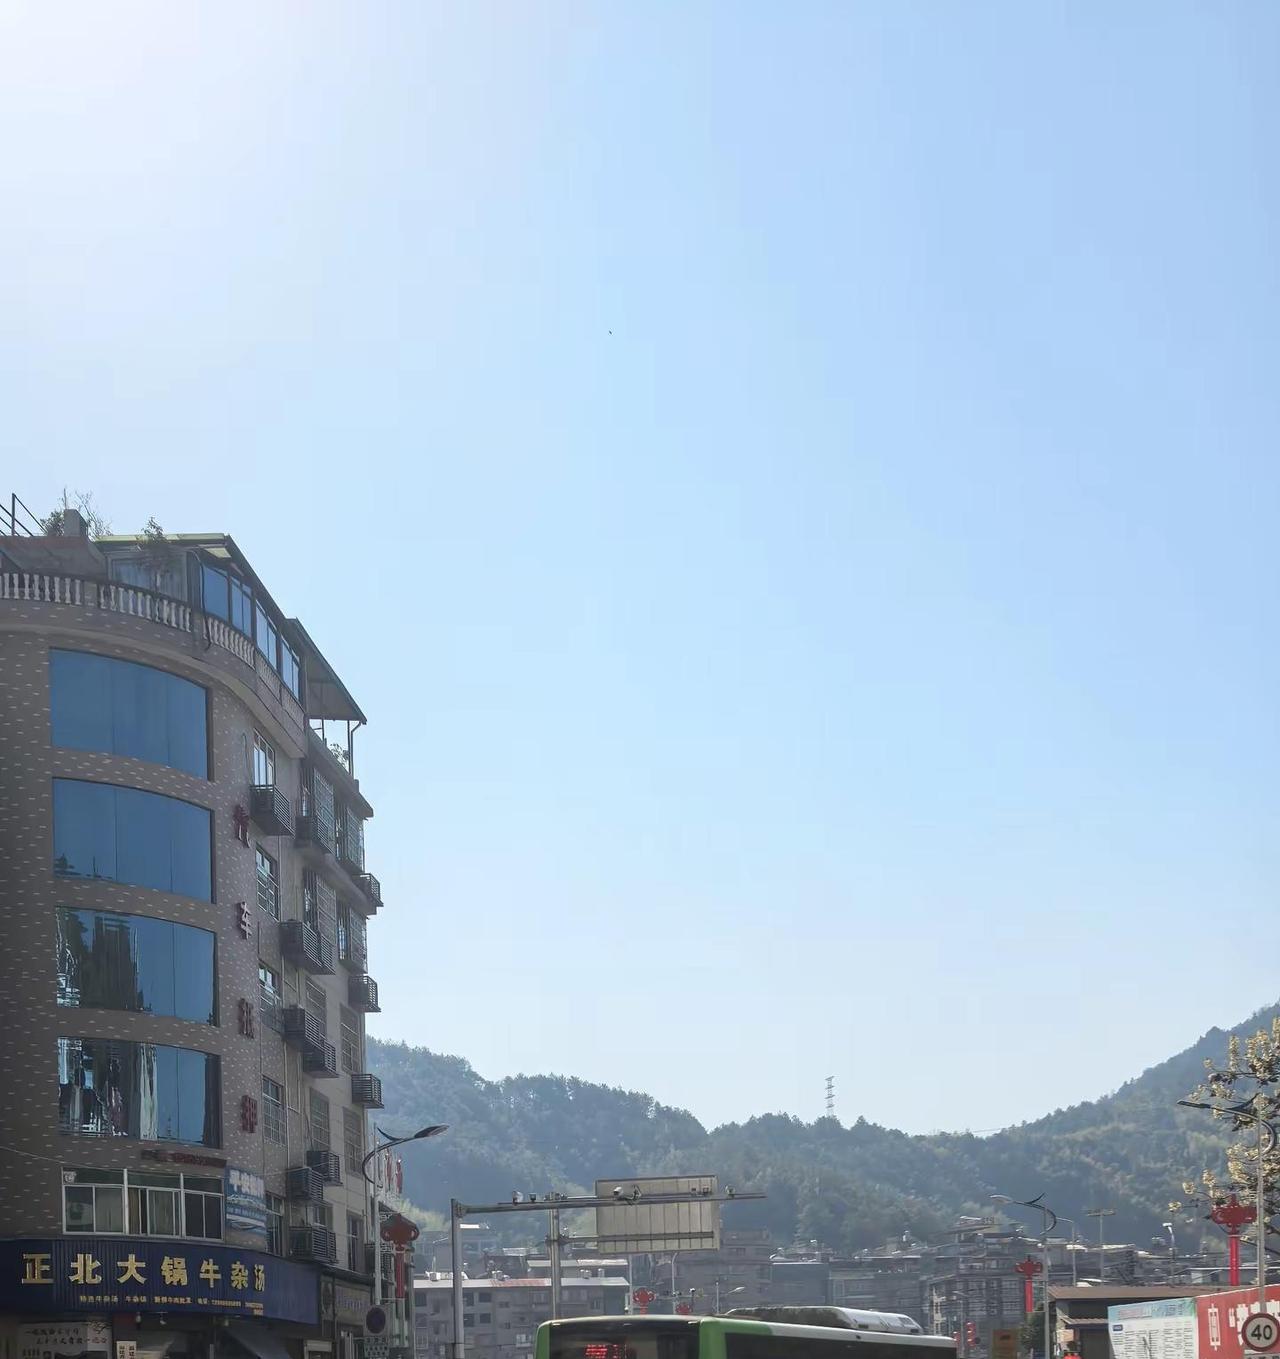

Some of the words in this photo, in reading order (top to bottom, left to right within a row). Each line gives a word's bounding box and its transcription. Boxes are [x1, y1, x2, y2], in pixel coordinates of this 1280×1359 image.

[21, 1253, 266, 1293] 正北大锅牛杂汤
[1251, 1323, 1273, 1341] 40
